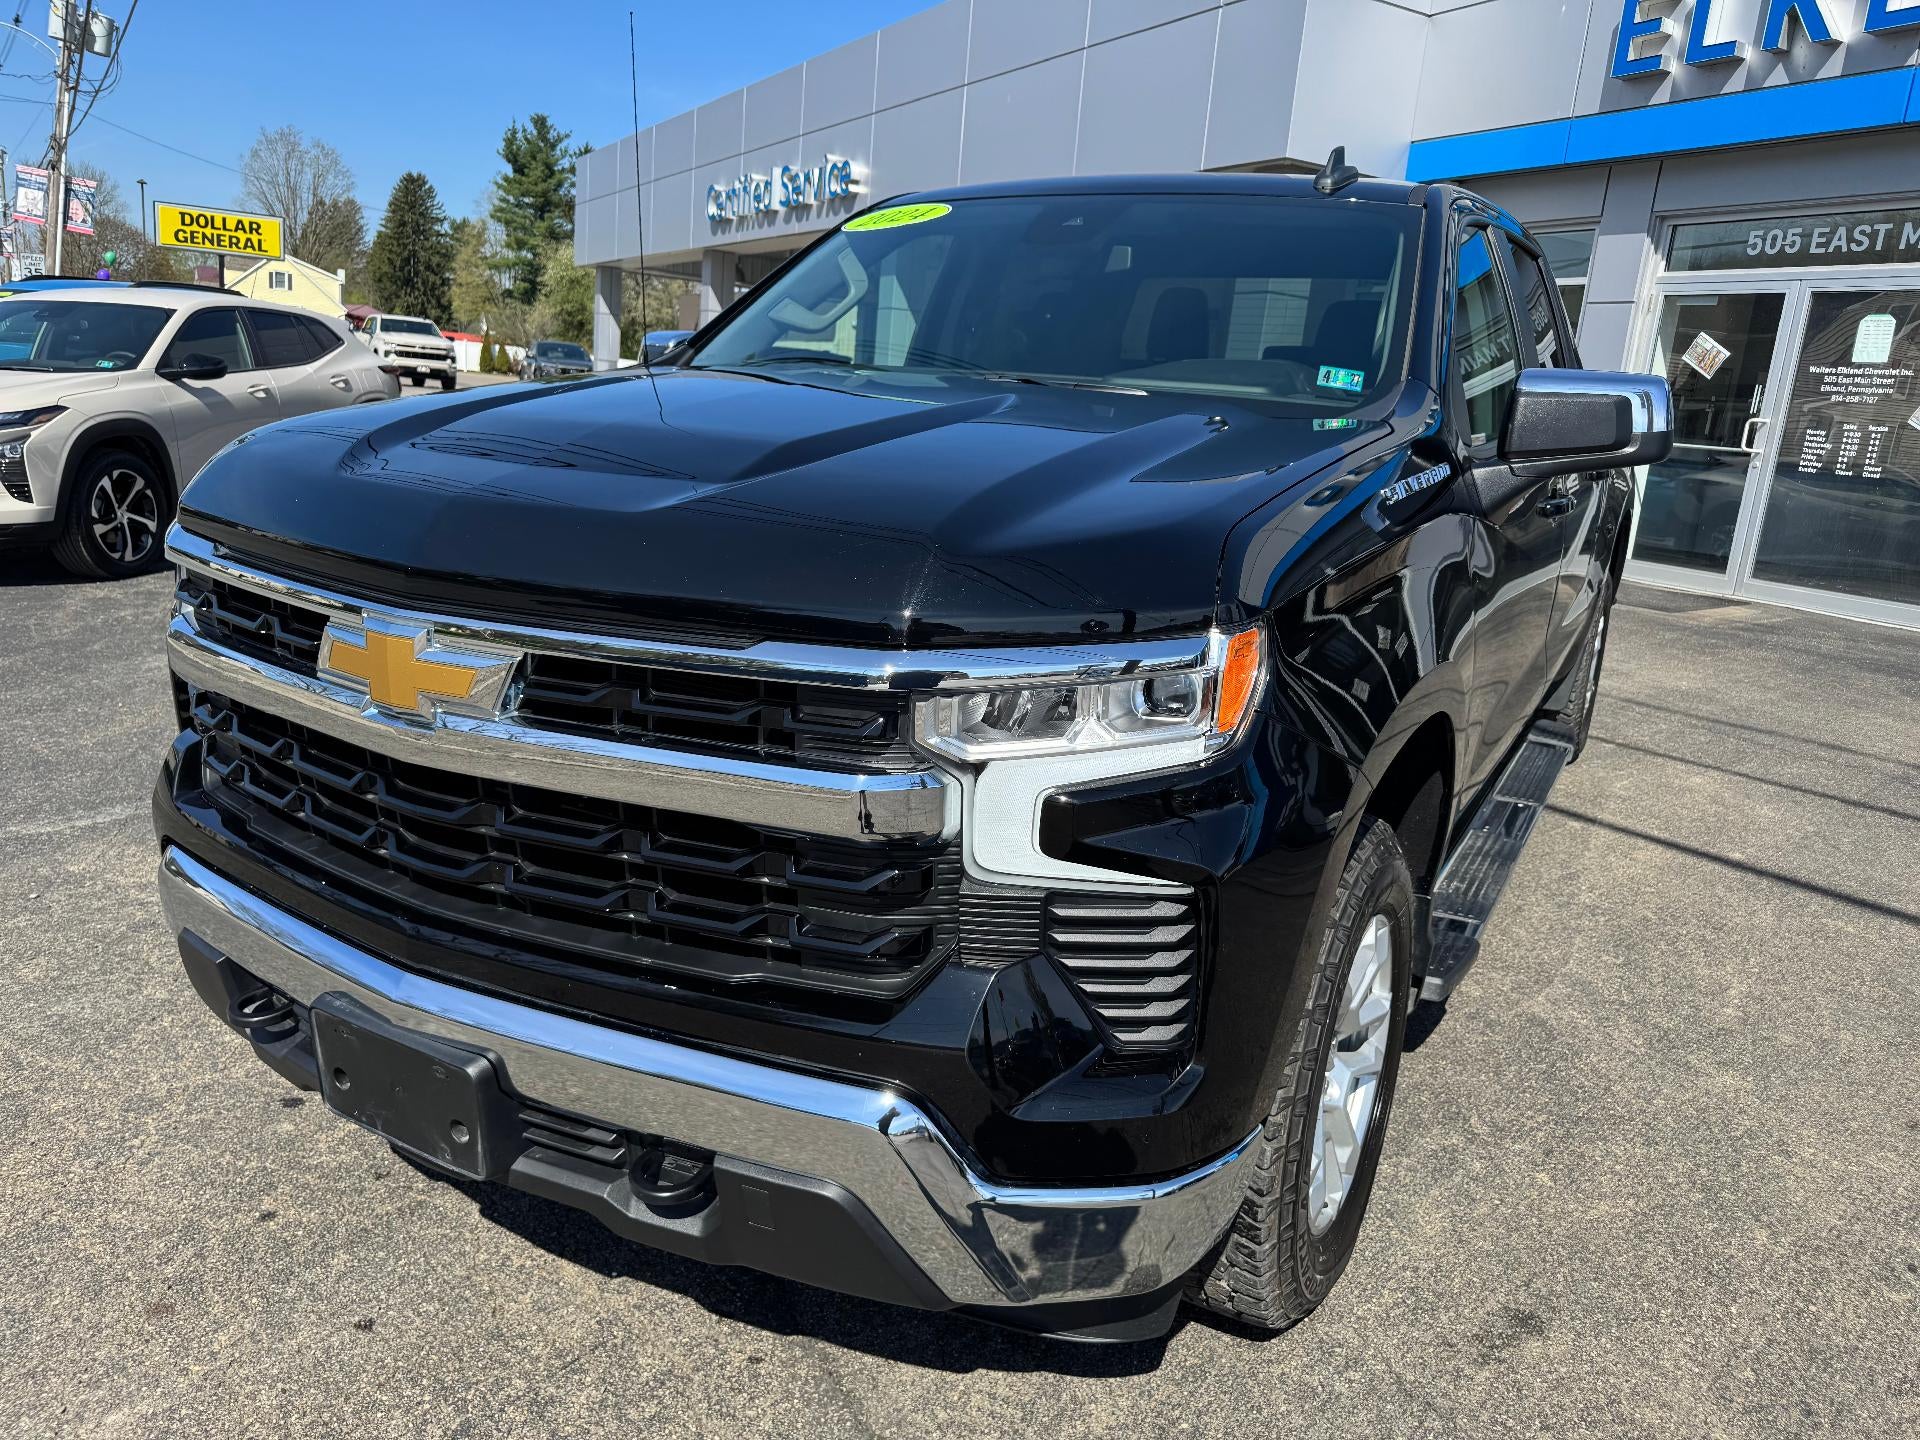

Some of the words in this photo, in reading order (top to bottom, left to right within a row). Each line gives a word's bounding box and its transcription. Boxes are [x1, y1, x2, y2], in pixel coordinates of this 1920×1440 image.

[706, 173, 774, 222] Certified
[780, 153, 852, 208] Service
[178, 211, 263, 236] DOLLAR
[173, 228, 269, 253] GENERAL
[1746, 227, 1803, 256] 505
[1809, 223, 1893, 254] EAST
[21, 254, 44, 262] SPEED
[23, 267, 43, 278] 35
[1837, 366, 1863, 375] Elkland
[1864, 367, 1900, 376] Chevrolet
[1322, 370, 1332, 384] 4
[1838, 376, 1853, 384] East
[1872, 377, 1895, 385] Street
[1847, 386, 1894, 395] Pennsylvania
[1868, 424, 1889, 432] Service
[1803, 441, 1833, 449] Wednesday
[1802, 447, 1826, 455] Thursday
[1799, 460, 1823, 468] Saturday
